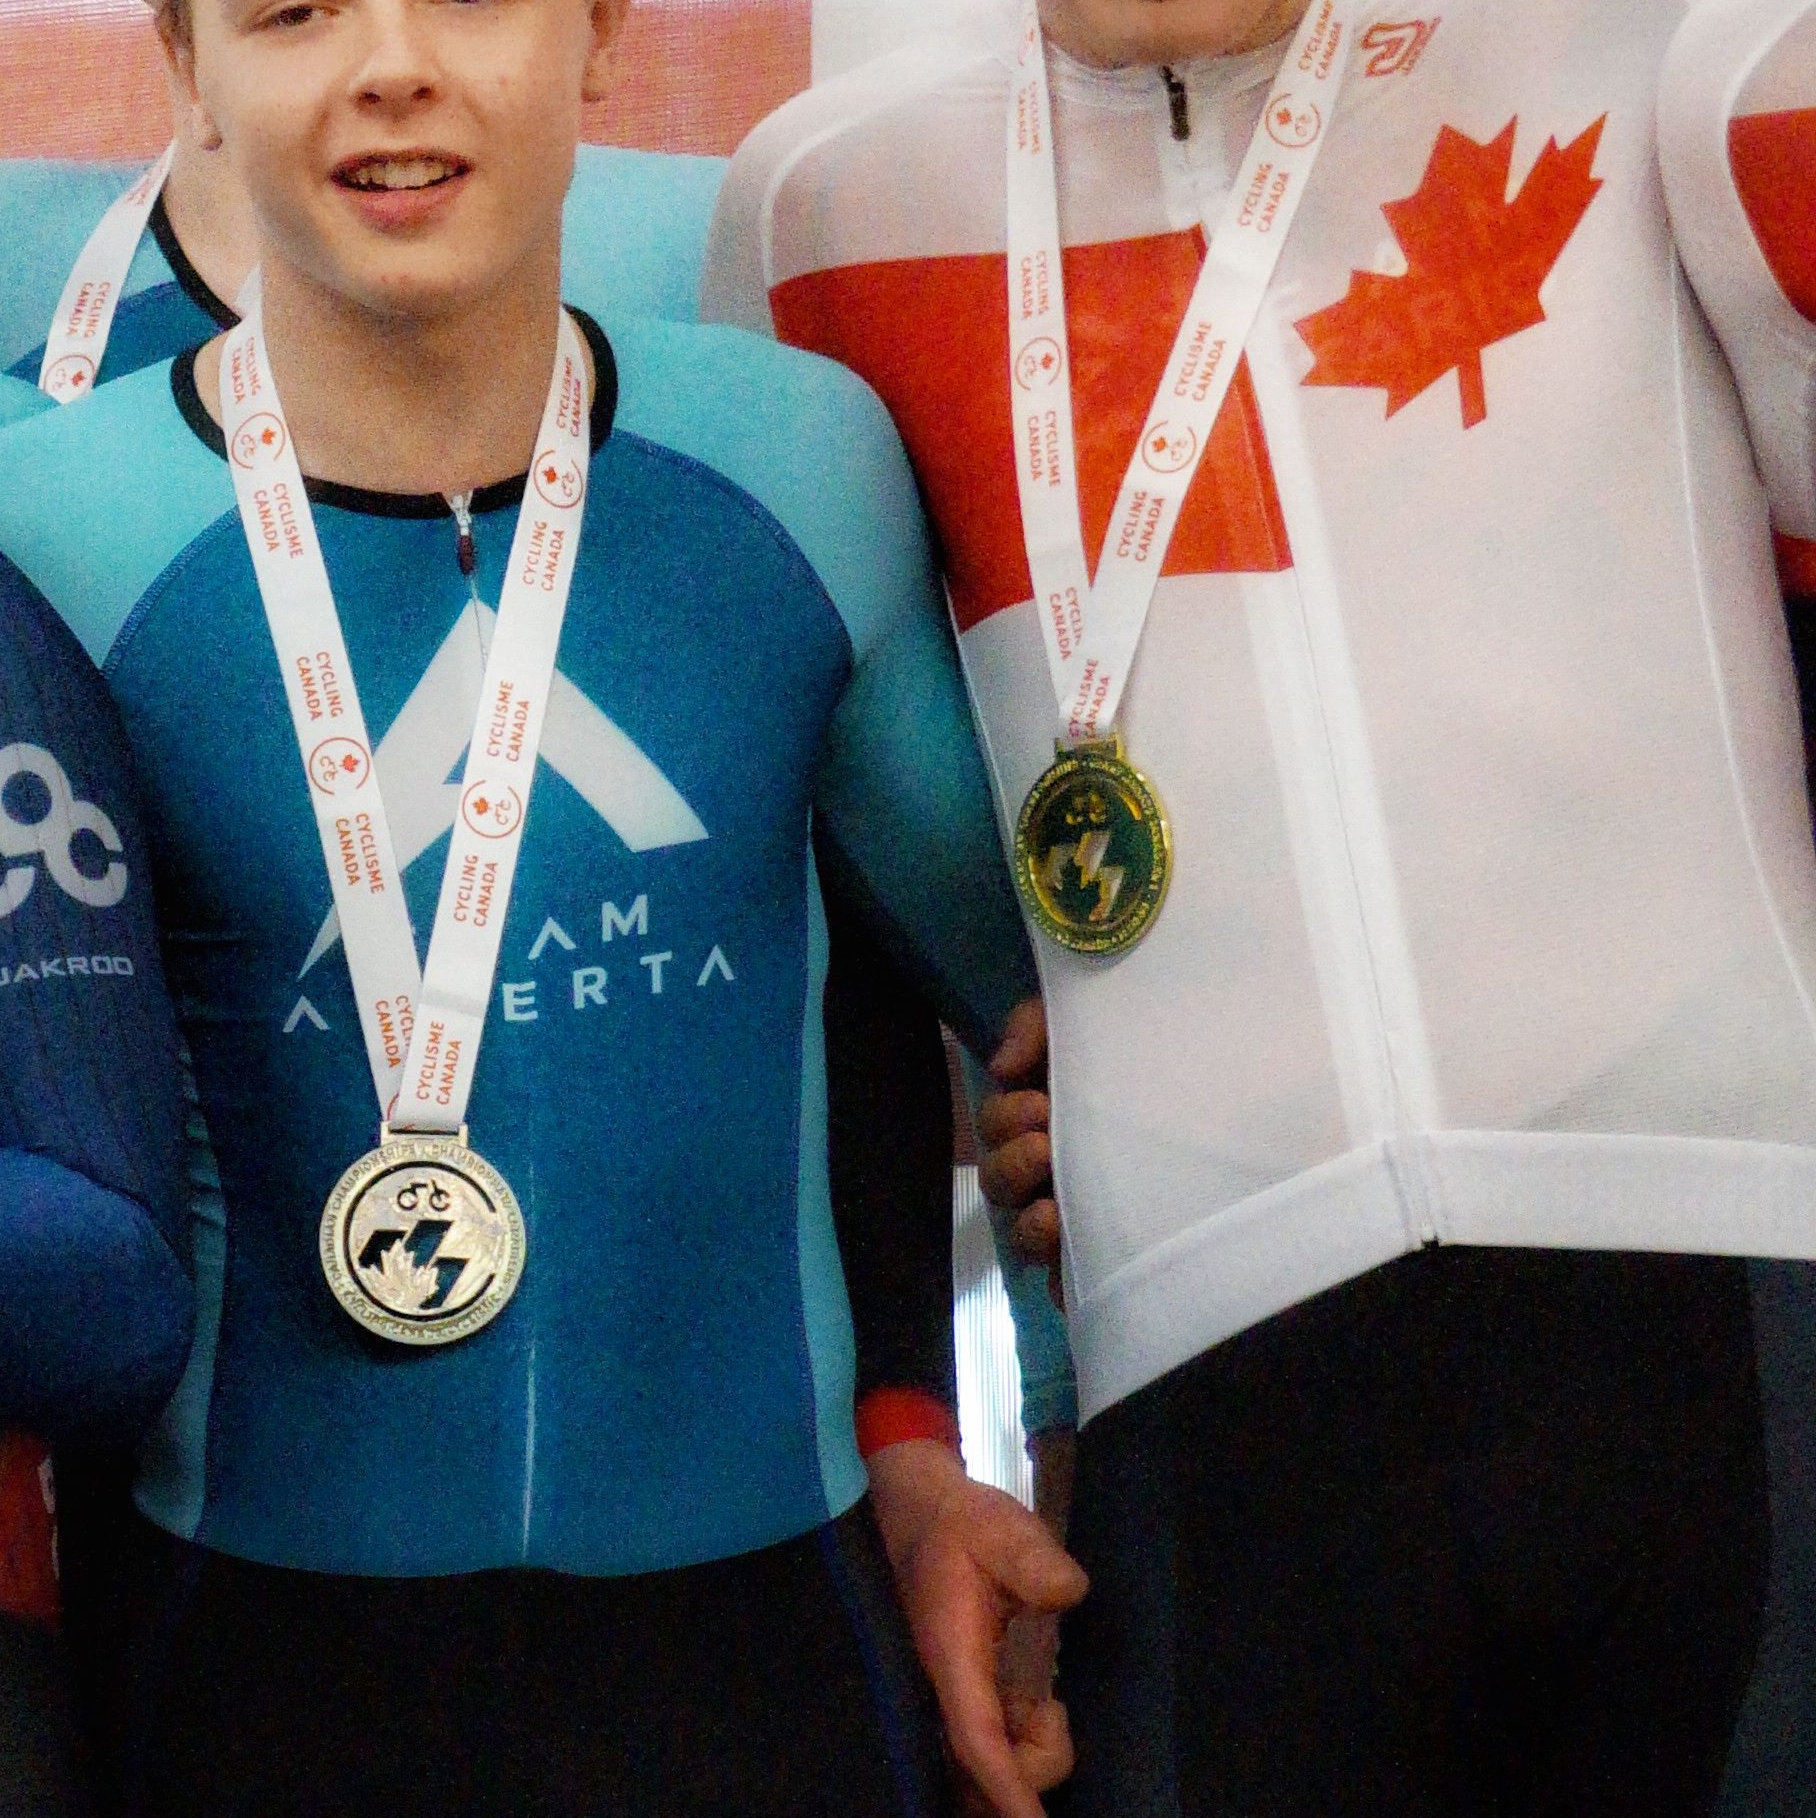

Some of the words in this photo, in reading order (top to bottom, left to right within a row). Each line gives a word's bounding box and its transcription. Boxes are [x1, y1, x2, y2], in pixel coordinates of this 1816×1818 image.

[1315, 21, 1343, 80] CANADA
[1238, 162, 1273, 227] CYCLING
[1257, 172, 1290, 233] CANADA
[66, 282, 94, 337] CANADA
[231, 347, 244, 404] CANADA
[245, 337, 262, 396] CYCLING
[1174, 320, 1212, 397] CYCLISME
[1192, 338, 1226, 402] CANADA
[1027, 414, 1044, 482] CANADA
[1045, 409, 1061, 489] CYCLISME
[254, 490, 279, 553] CANADA
[273, 483, 304, 560] CYCLISME
[521, 521, 547, 585] CYCLING
[1116, 491, 1147, 558] CYCLING
[1135, 497, 1165, 562] CANADA
[540, 530, 565, 591] CANADA
[1049, 593, 1072, 661] CANADA
[296, 656, 322, 722] CANADA
[316, 651, 343, 718] CYCLING
[487, 680, 514, 758] CYCLISME
[507, 700, 530, 763] CANADA
[336, 818, 361, 886] CANADA
[356, 813, 385, 894] CYCLISME
[453, 854, 479, 922] CYCLING
[474, 862, 499, 927] CANADA
[283, 944, 736, 1034] AERTA
[375, 1000, 401, 1068] CANADA
[416, 1021, 445, 1100] CYCLISME
[436, 1039, 462, 1106] CANADA
